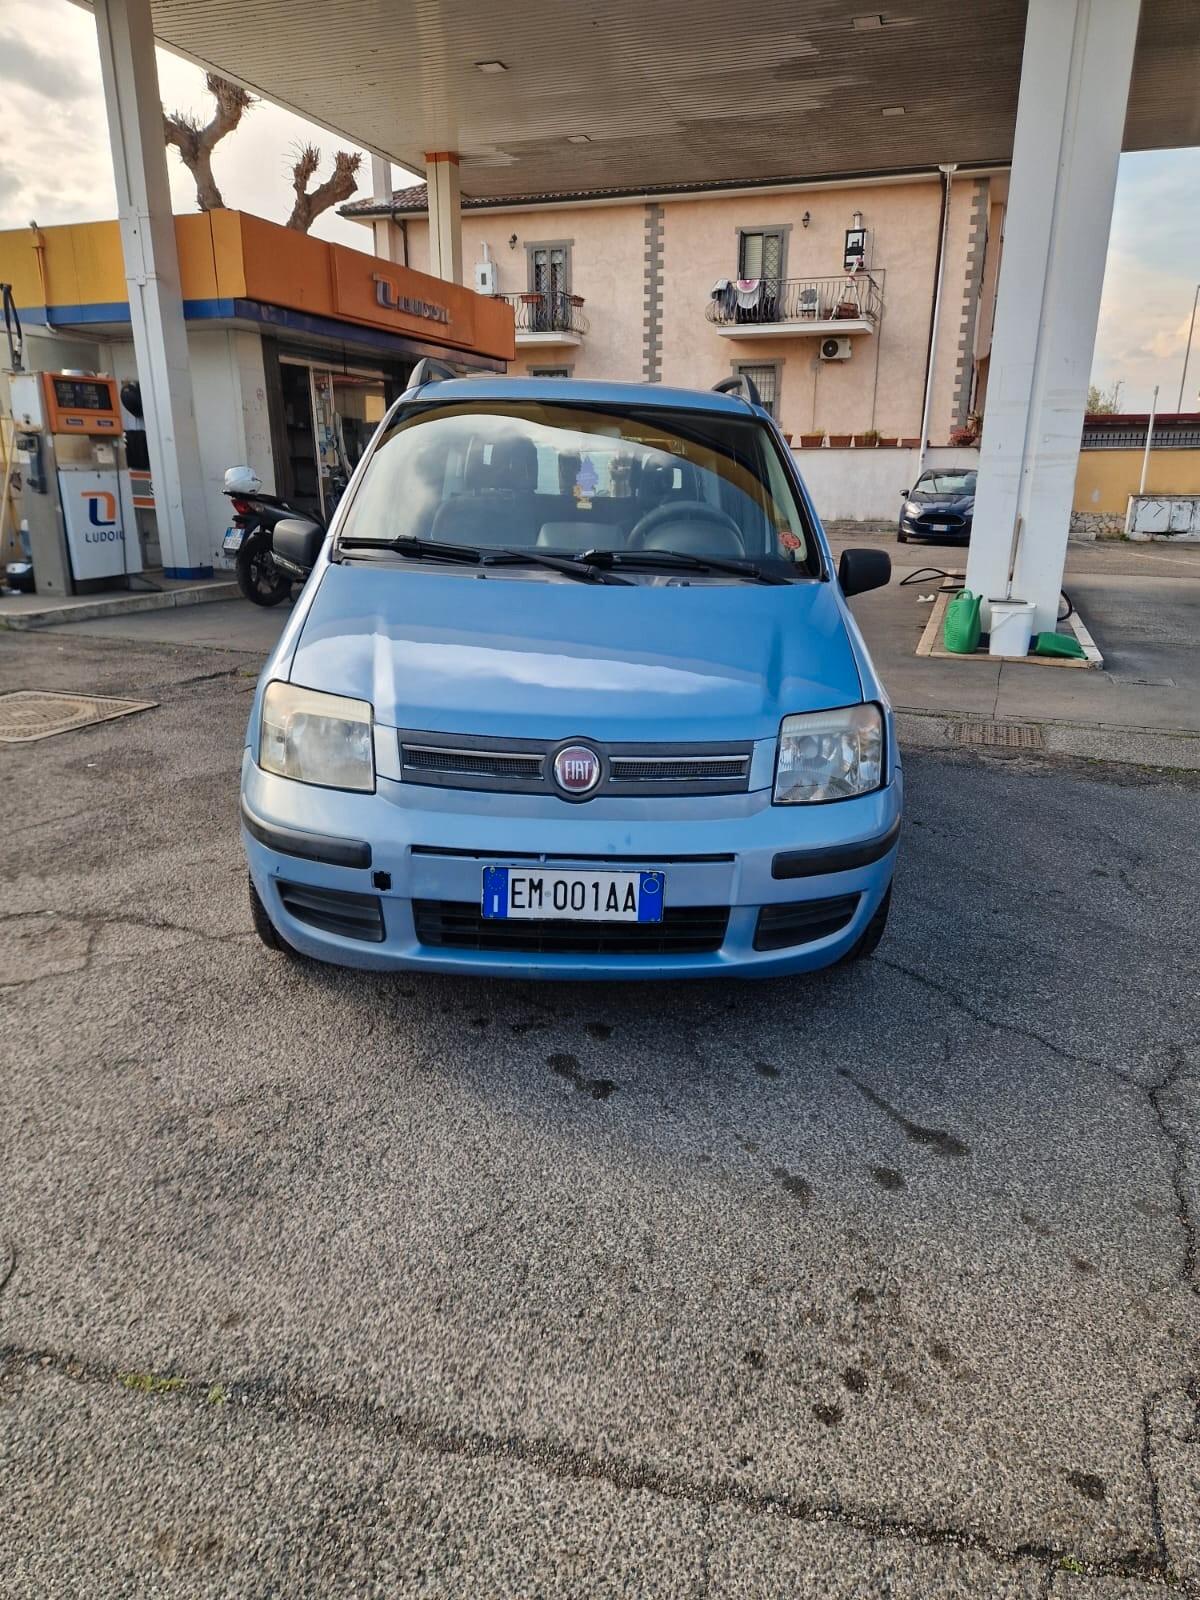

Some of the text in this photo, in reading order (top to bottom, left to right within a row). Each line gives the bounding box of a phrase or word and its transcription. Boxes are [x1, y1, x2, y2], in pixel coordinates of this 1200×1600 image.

[85, 531, 124, 543] LUDOIL
[565, 760, 590, 780] FIAT
[511, 878, 637, 912] EM 001AA
